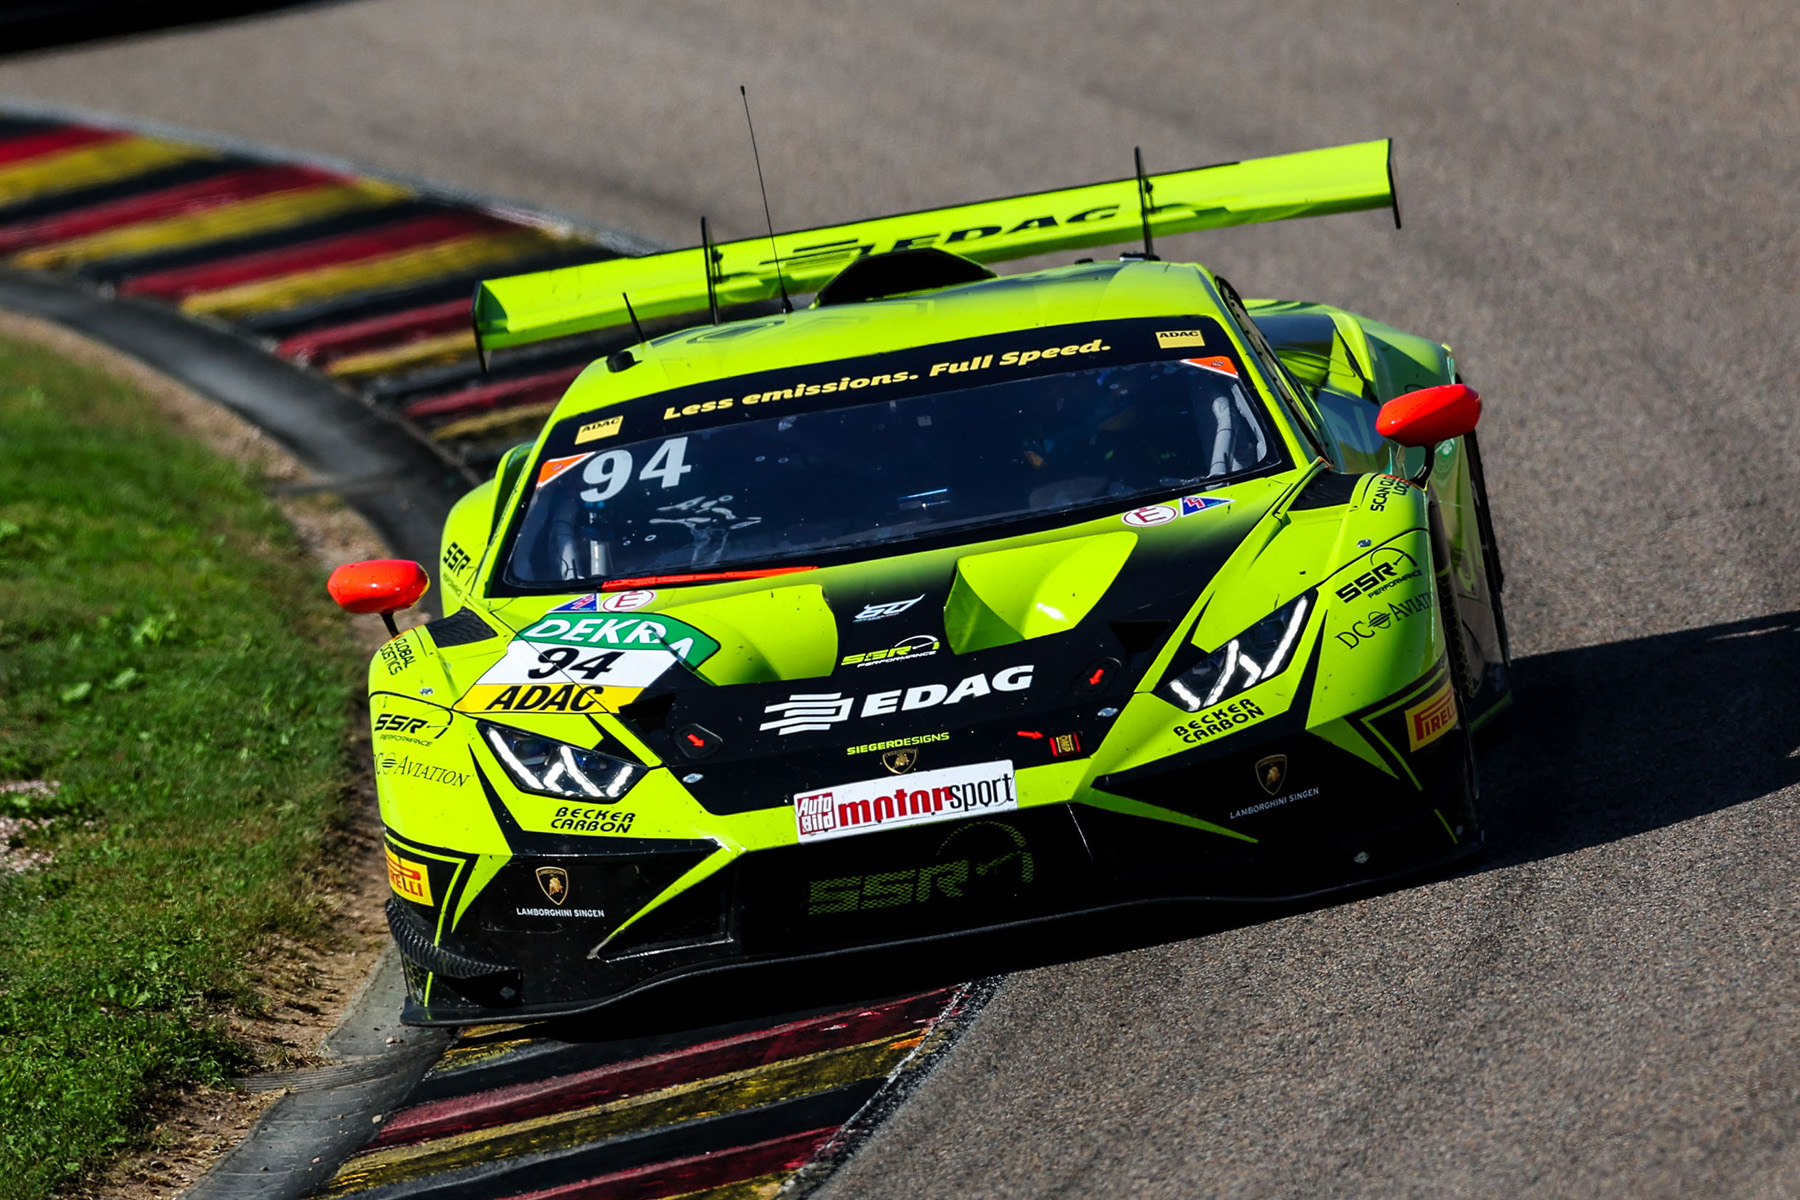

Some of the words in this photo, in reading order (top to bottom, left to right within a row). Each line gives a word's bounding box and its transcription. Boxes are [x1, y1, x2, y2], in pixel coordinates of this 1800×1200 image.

[1159, 331, 1200, 339] ADAC
[663, 397, 734, 420] Less
[742, 370, 919, 406] emissions.
[929, 354, 993, 377] Full
[999, 338, 1112, 367] Speed.
[581, 417, 621, 433] ADAC
[580, 436, 692, 502] 94
[1370, 486, 1391, 512] SCAN
[443, 541, 471, 577] SSR
[1335, 562, 1398, 604] SSR
[1334, 620, 1376, 650] DC
[527, 647, 626, 680] 94
[841, 645, 913, 666] SSR
[857, 650, 937, 669] PERFORMANCE
[484, 685, 605, 711] ADAC
[860, 665, 1035, 718] EDAG
[374, 714, 429, 734] SSR
[1173, 699, 1256, 736] BECKER
[1183, 706, 1265, 743] CARBON
[846, 732, 950, 756] SIEGERDESIGNS
[393, 755, 470, 787] AVIATION
[555, 807, 636, 823] BECKER
[799, 793, 833, 816] Auto
[1230, 797, 1287, 819] LAMBORGHINI
[1288, 787, 1319, 802] SINGEN
[551, 818, 632, 833] CARBON
[801, 812, 836, 834] Bild
[808, 859, 969, 916] SSR
[516, 907, 572, 917] LAMBORGHINI
[573, 909, 605, 918] SINGEN
